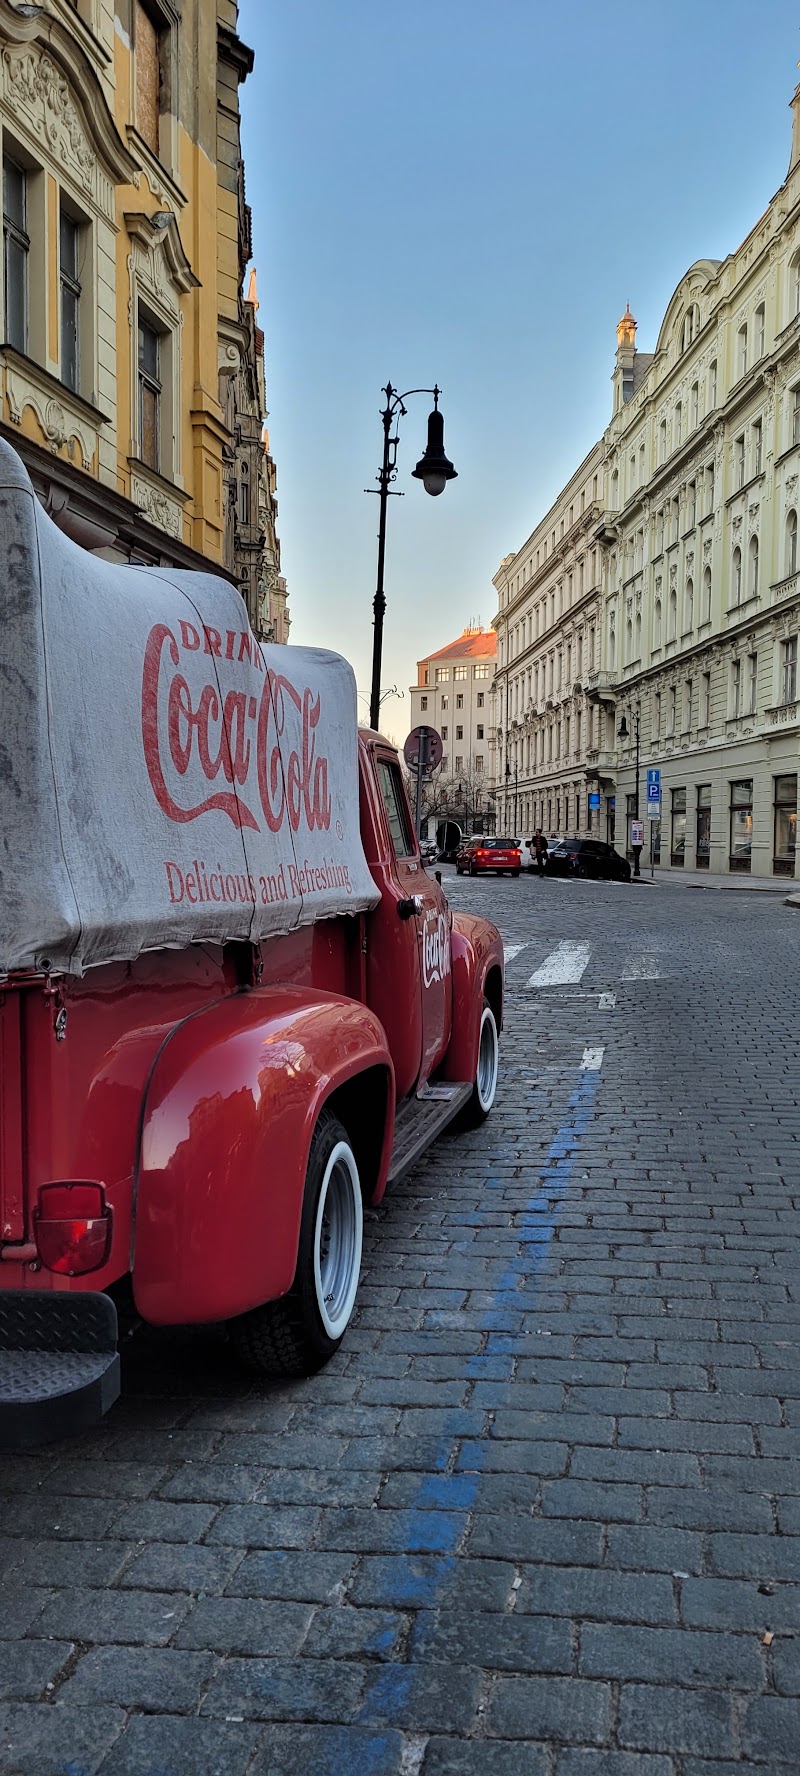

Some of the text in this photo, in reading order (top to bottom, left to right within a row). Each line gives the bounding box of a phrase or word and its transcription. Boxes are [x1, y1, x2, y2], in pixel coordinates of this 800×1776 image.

[177, 619, 263, 672] DRINK
[163, 857, 352, 904] Delicious and Refreshing
